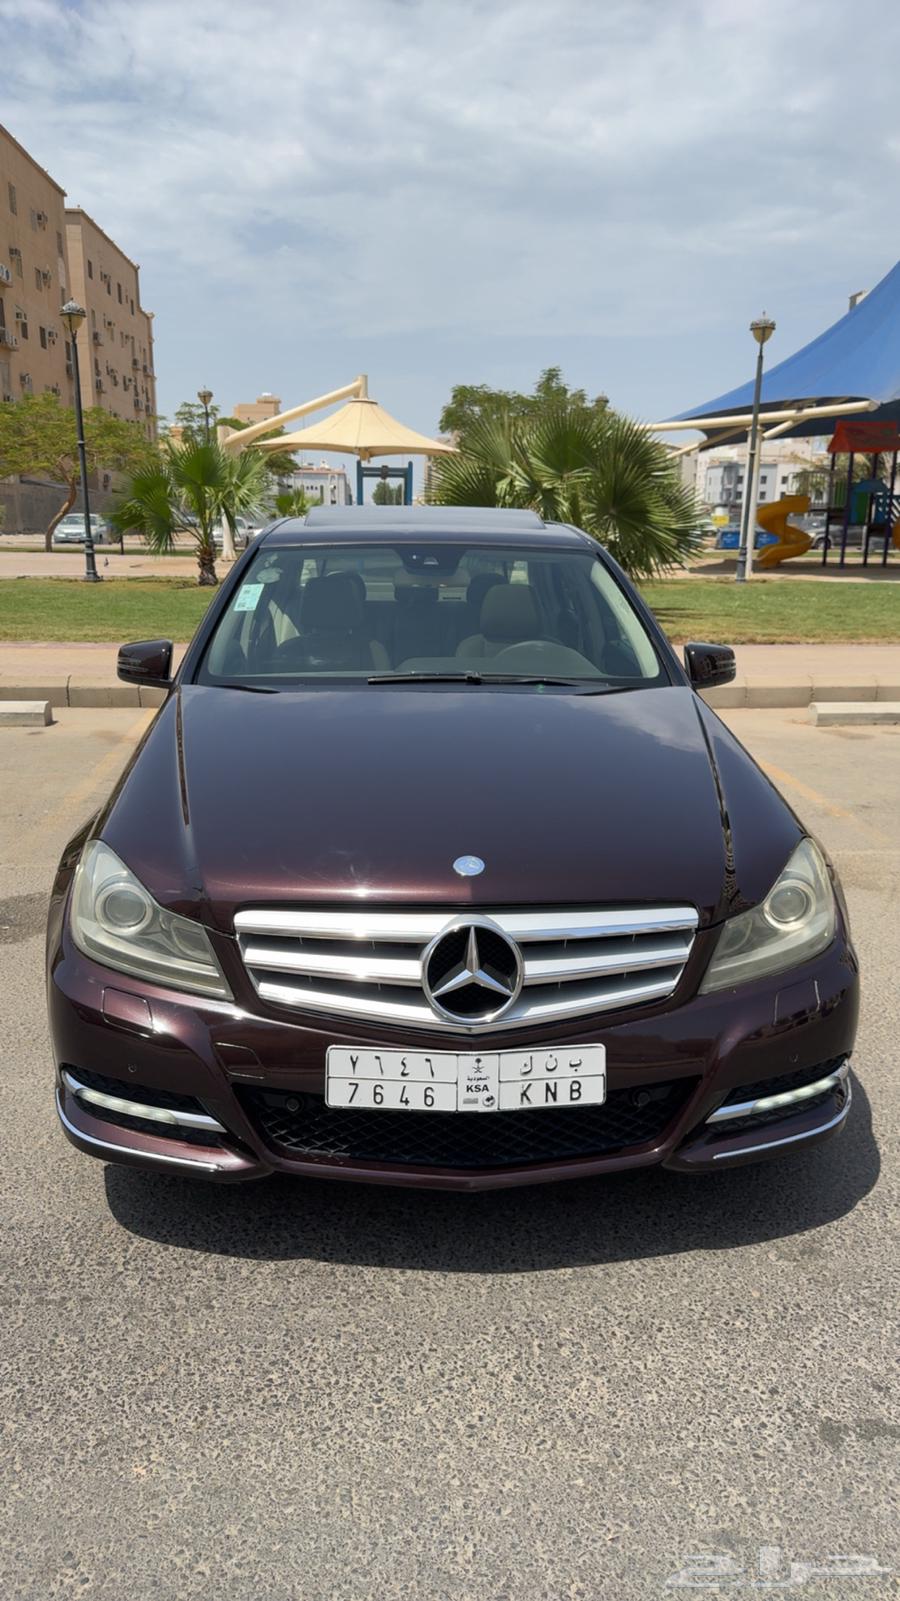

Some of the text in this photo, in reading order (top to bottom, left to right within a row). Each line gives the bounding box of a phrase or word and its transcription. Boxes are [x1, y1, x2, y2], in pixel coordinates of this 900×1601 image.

[348, 1082, 436, 1108] 7646
[466, 1084, 490, 1093] KSA
[520, 1080, 583, 1104] KNB
